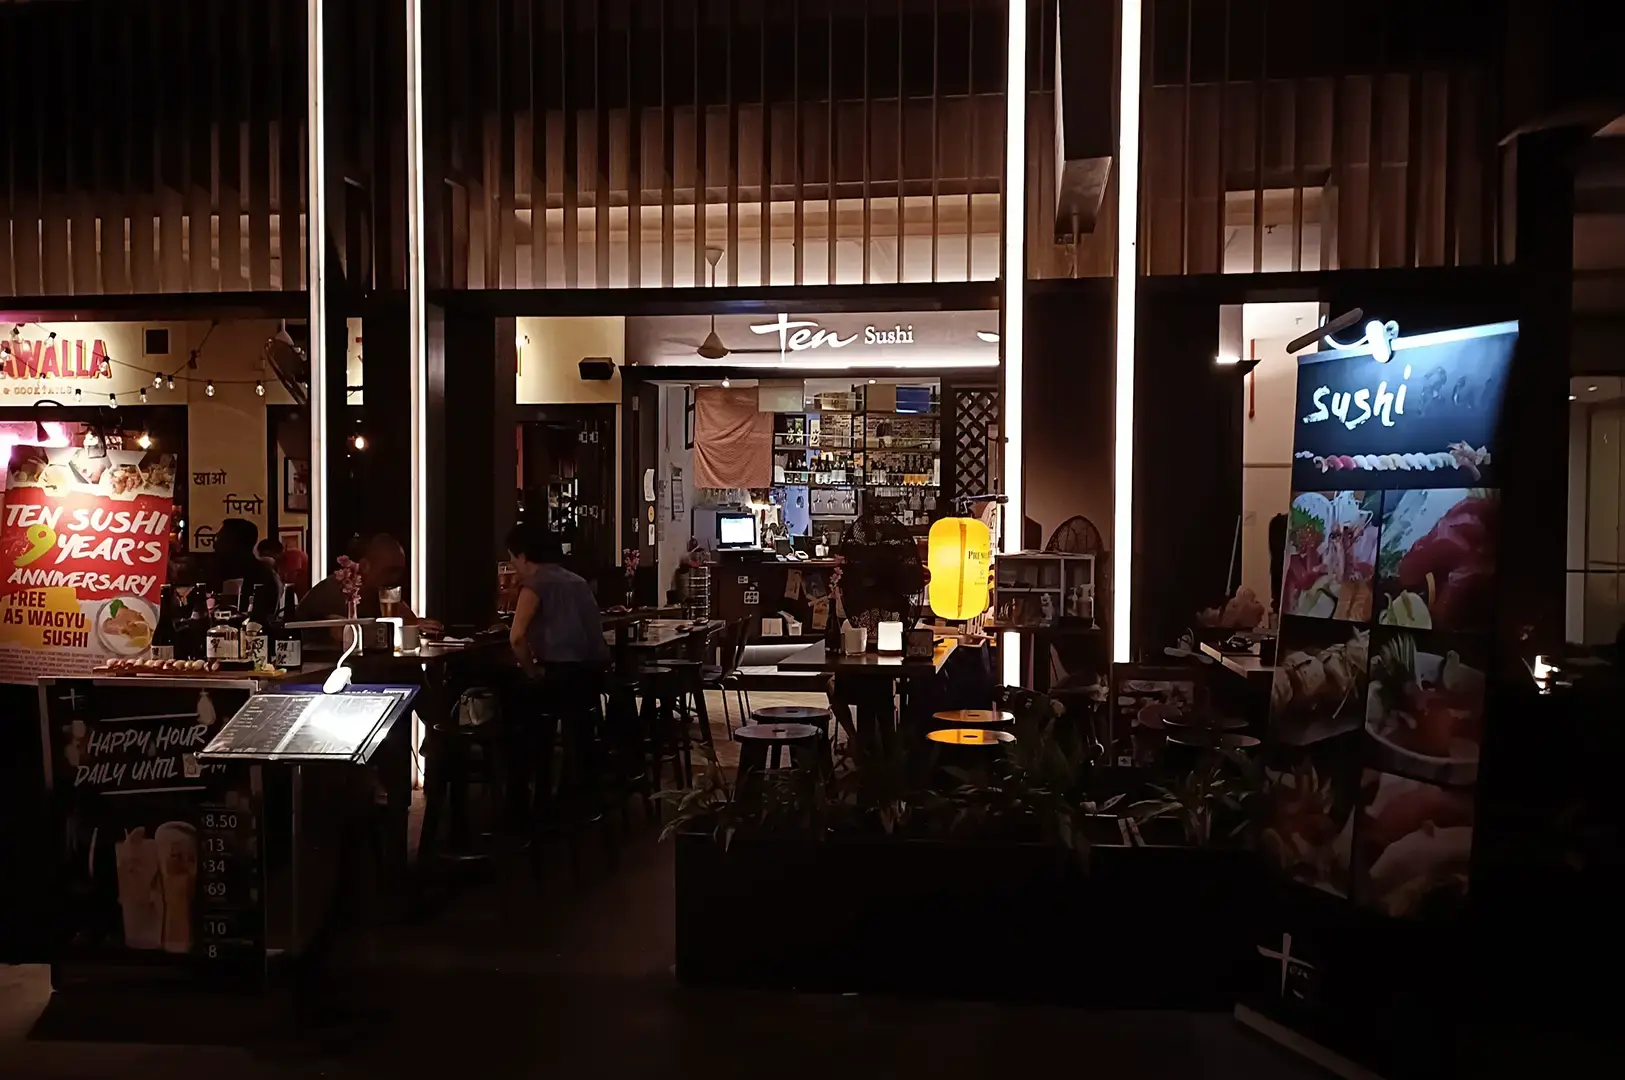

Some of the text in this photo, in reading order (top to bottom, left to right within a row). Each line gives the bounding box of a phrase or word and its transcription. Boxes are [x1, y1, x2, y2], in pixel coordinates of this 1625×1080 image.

[864, 325, 914, 345] Sushi
[193, 469, 227, 486] खाओ
[223, 493, 263, 514] पियो
[5, 504, 168, 536] TEN SUSHI
[14, 523, 162, 566] 9 YEAR'S
[7, 567, 156, 596] ANNIVERSARY
[10, 591, 46, 607] FREE
[4, 608, 86, 629] A5 WAGYU
[43, 629, 89, 648] SUSHI
[87, 723, 208, 756] HAPPY HOUR
[73, 760, 127, 788] DAILY
[131, 756, 178, 780] UNTIL
